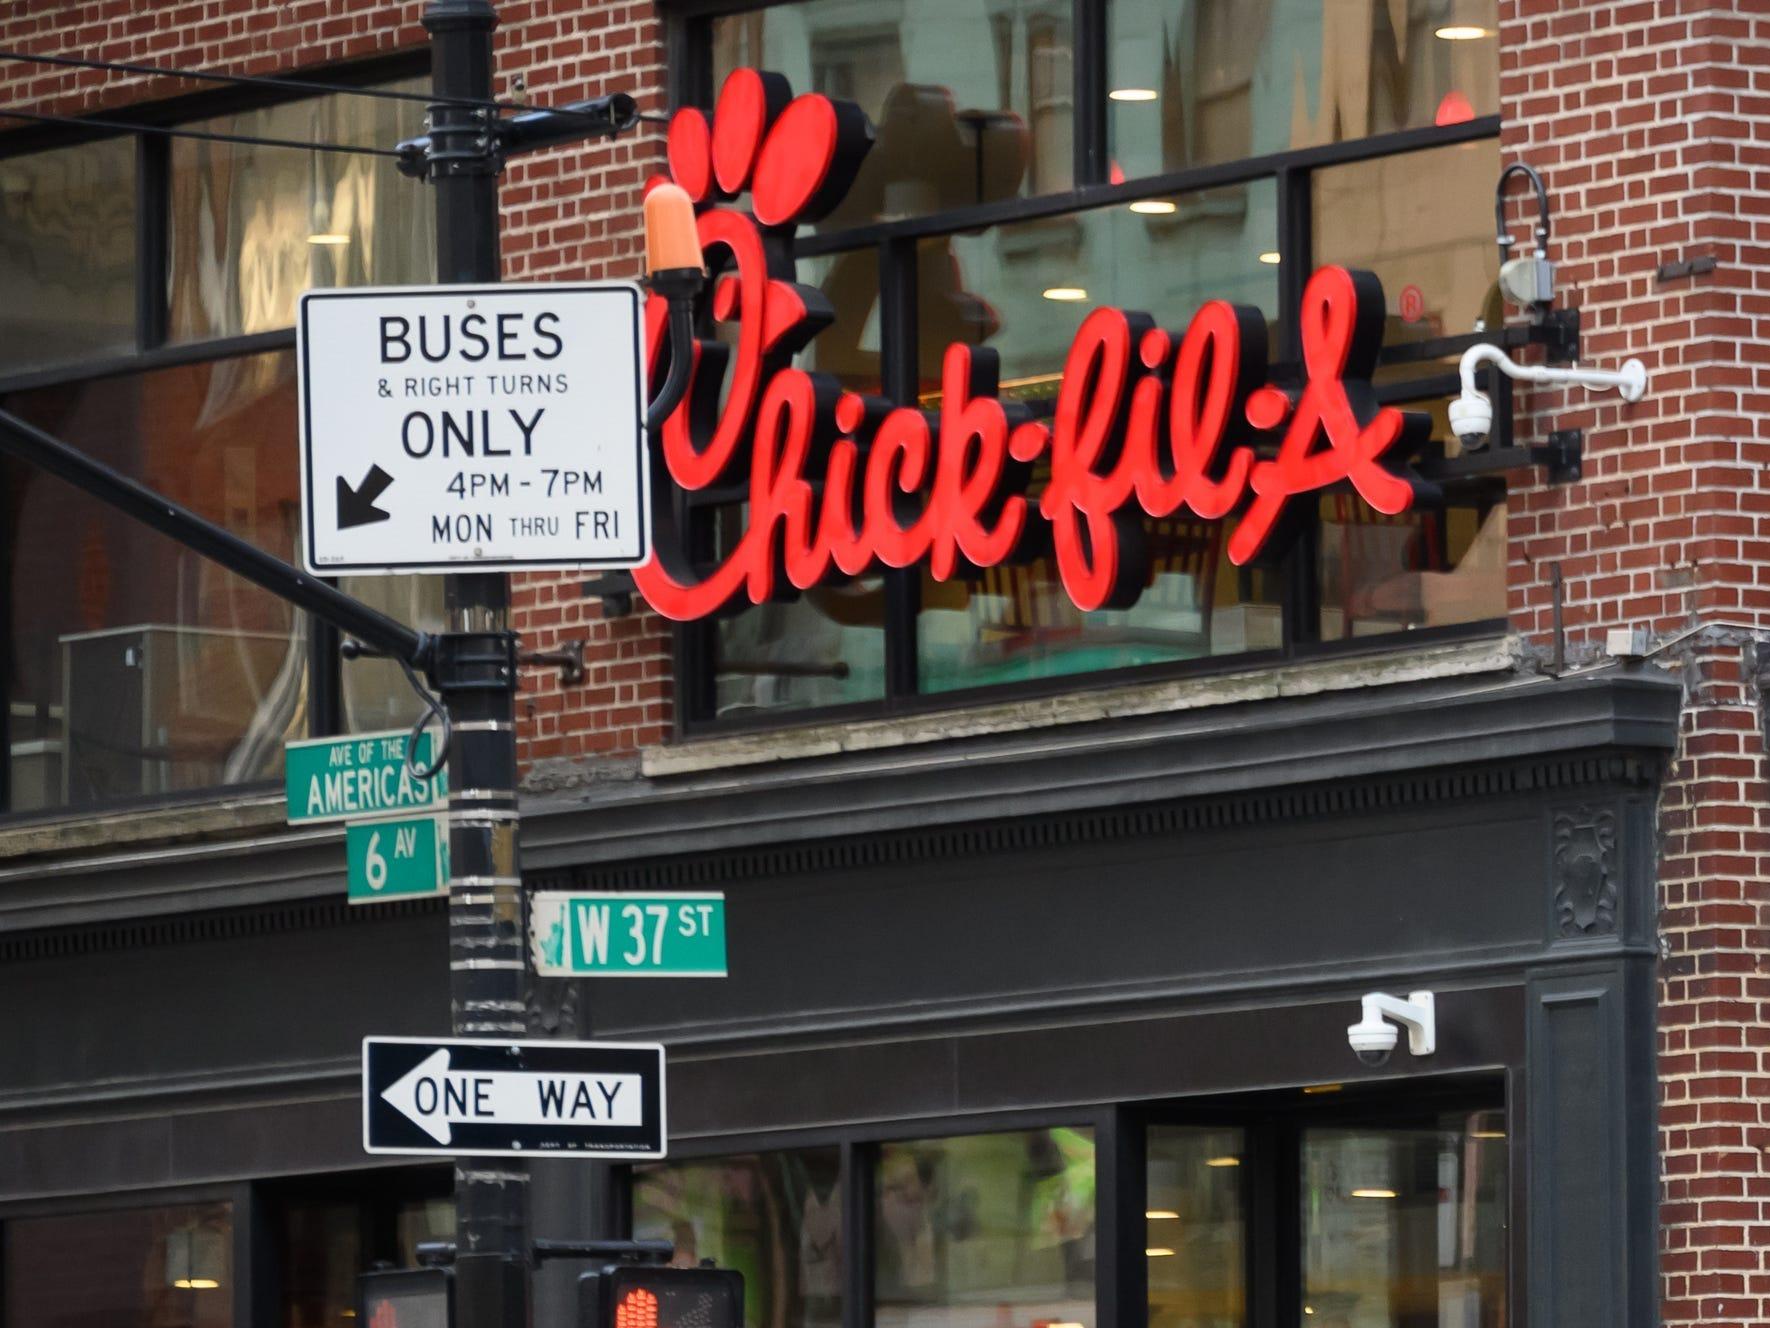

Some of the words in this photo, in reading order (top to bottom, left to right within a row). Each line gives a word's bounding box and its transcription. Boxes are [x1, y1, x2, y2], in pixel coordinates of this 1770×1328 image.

[379, 311, 563, 363] BUSES
[378, 379, 393, 398] &
[405, 376, 475, 397] RIGHT
[487, 374, 569, 395] TURNS
[401, 408, 545, 459] ONLY
[446, 471, 510, 499] 4PM
[541, 469, 602, 497] 7PM
[432, 514, 493, 543] MON
[510, 517, 559, 537] THRU
[575, 511, 619, 540] FRI
[329, 743, 353, 766] AVE
[358, 743, 374, 763] OF
[381, 739, 405, 760] THE
[307, 761, 429, 816] AMERICAS
[365, 831, 387, 891] 6
[394, 828, 417, 859] AV
[577, 905, 609, 965] W
[622, 905, 669, 966] 37
[678, 905, 714, 937] ST
[414, 1077, 495, 1117] ONE
[538, 1080, 622, 1120] WAY
